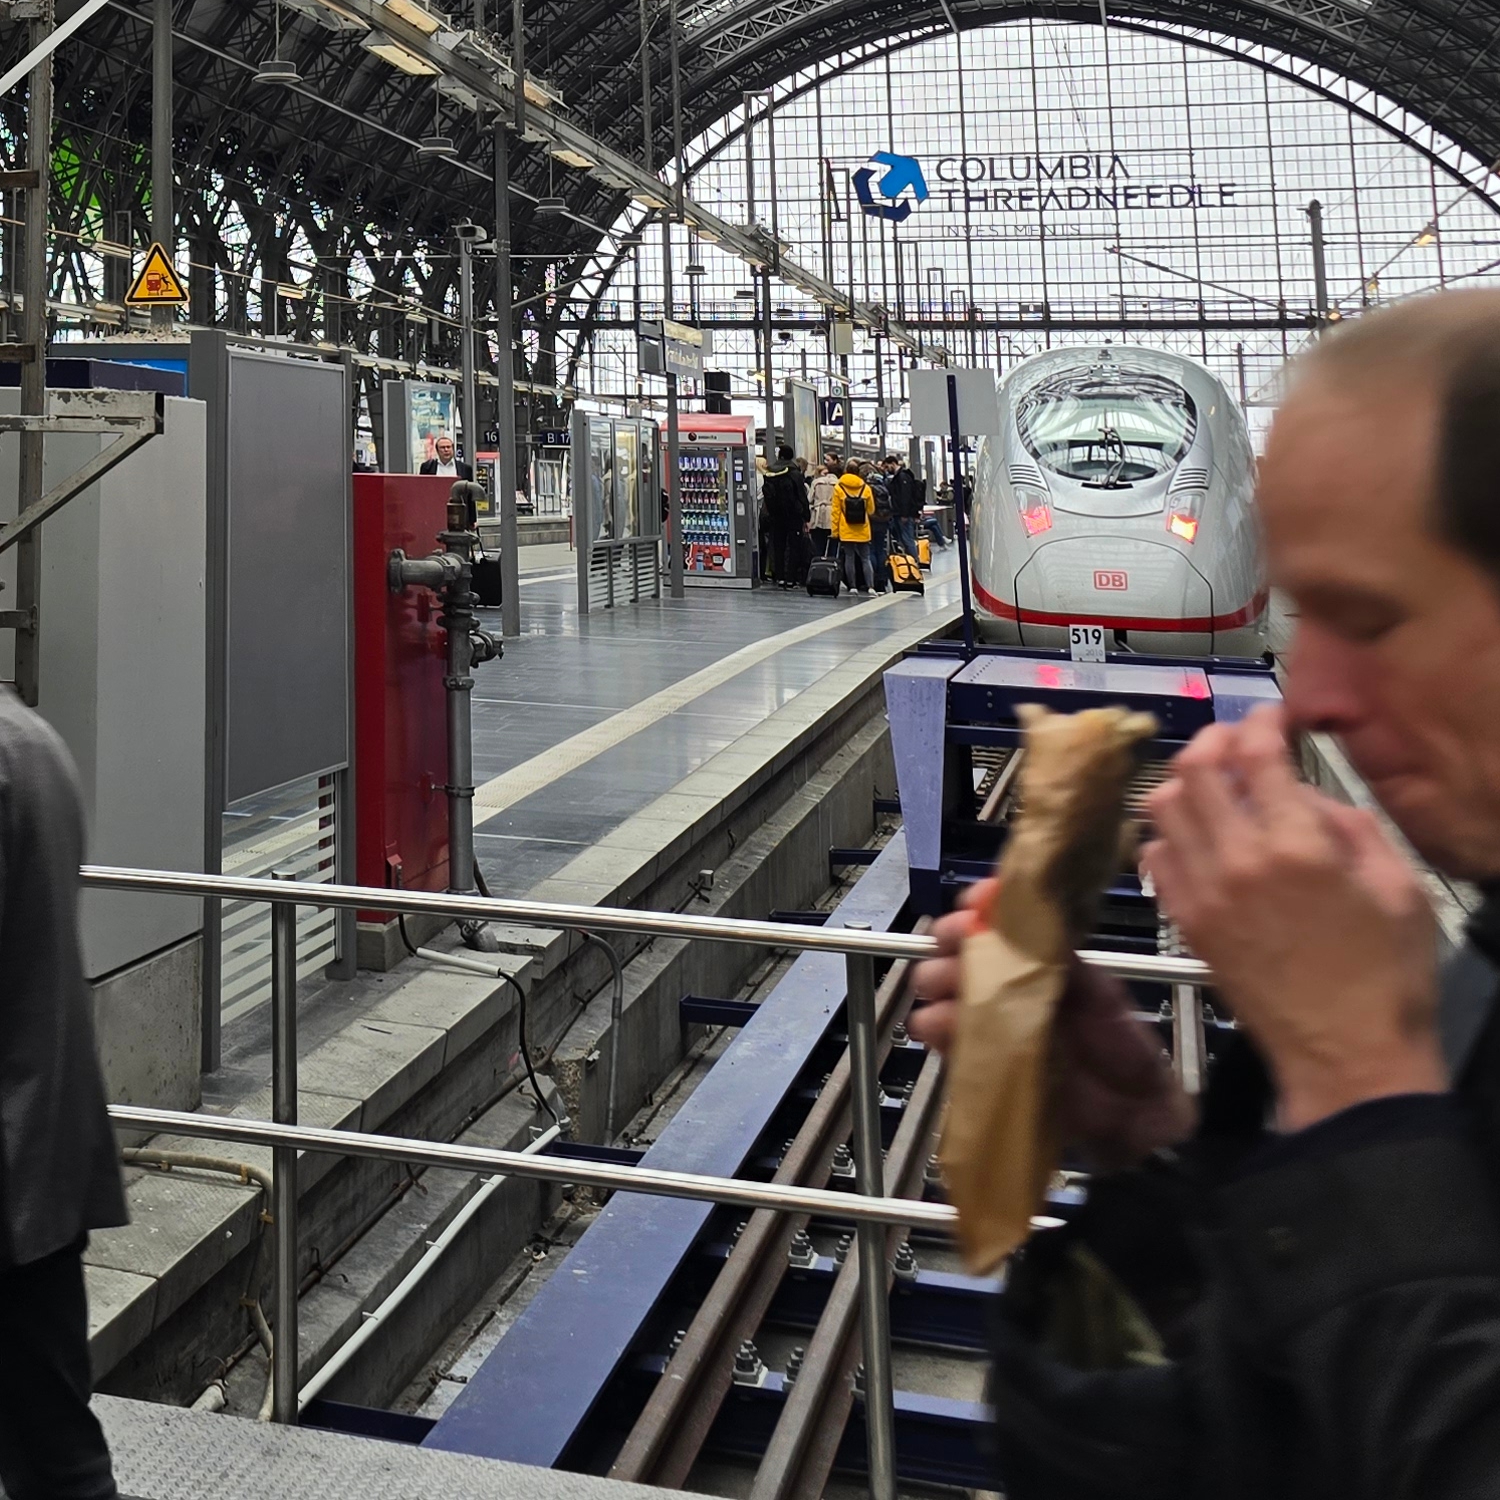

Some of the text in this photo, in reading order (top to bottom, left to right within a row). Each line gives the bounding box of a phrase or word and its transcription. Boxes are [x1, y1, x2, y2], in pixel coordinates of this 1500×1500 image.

[936, 154, 1131, 182] COLUMBIA
[938, 183, 1239, 212] THREADNEEDLE
[486, 431, 497, 442] 16
[547, 432, 555, 443] B
[1097, 573, 1124, 588] DB
[1071, 628, 1102, 645] 519
